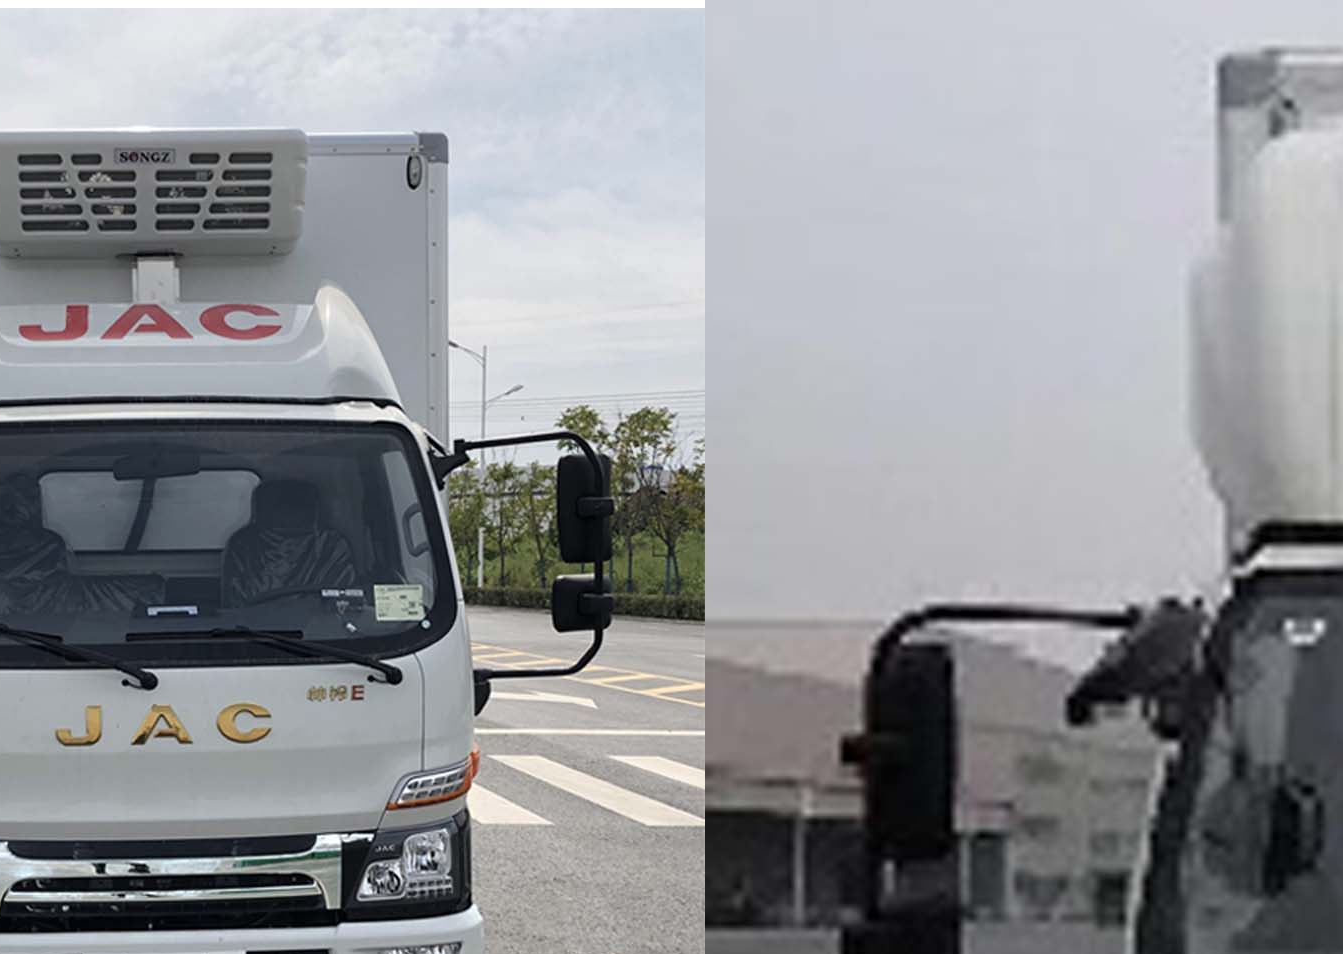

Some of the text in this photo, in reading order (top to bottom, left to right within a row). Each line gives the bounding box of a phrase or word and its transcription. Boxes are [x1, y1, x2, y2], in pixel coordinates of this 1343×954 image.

[119, 151, 172, 163] SONGZ
[17, 304, 283, 342] JAC
[55, 702, 273, 747] JAC
